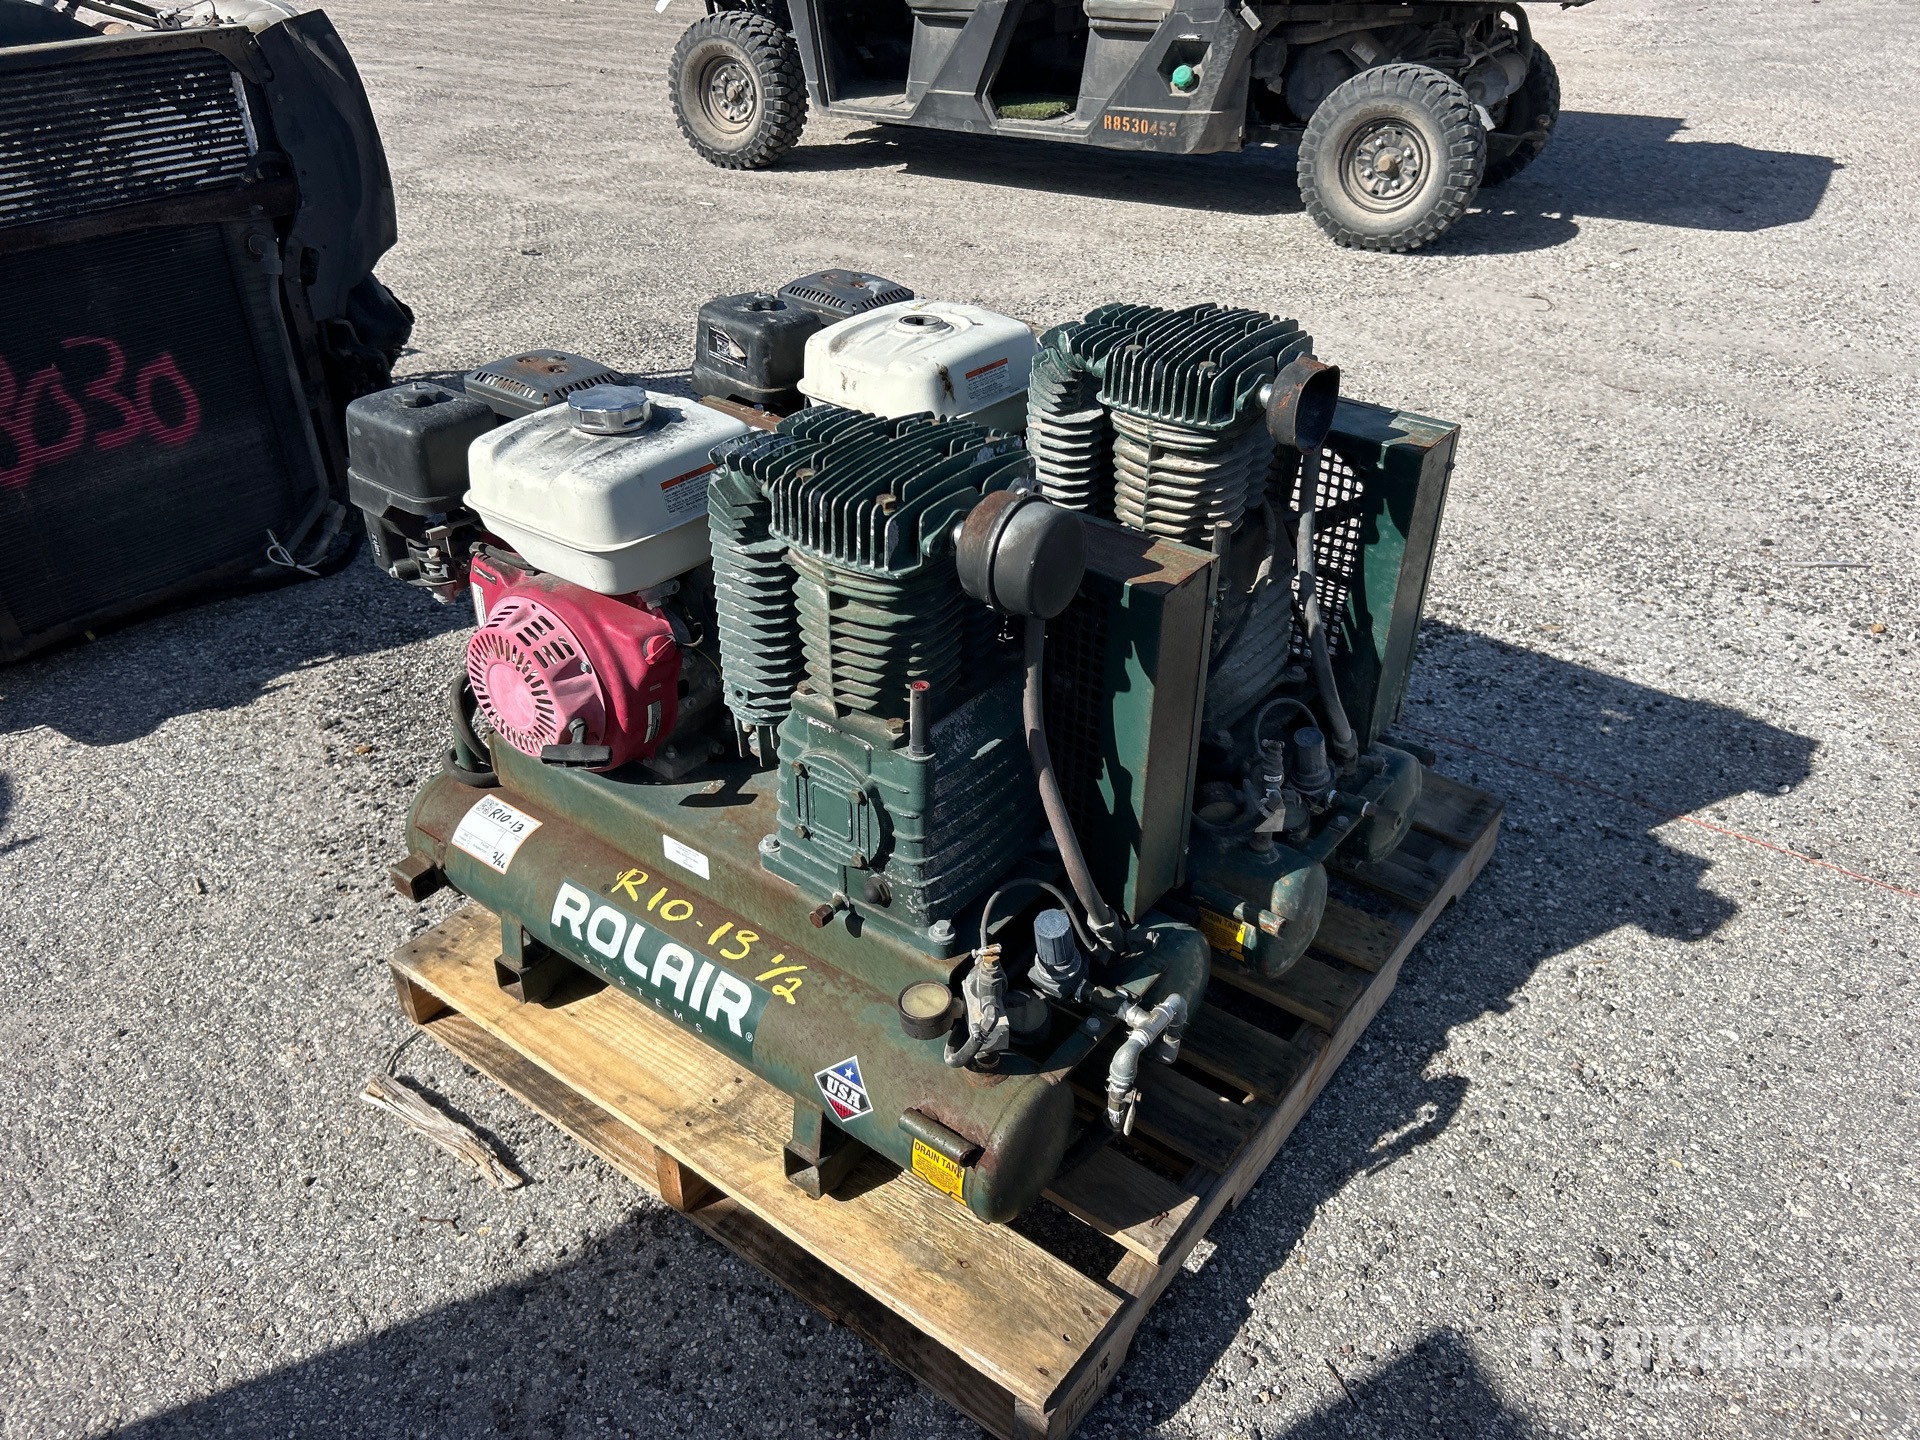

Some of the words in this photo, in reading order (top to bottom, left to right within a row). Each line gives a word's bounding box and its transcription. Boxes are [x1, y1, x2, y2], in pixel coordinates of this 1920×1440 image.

[1104, 114, 1178, 137] R8530453
[551, 882, 752, 1038] ROLAIR
[583, 953, 703, 1034] SYSTEMS
[826, 1076, 861, 1110] USA
[914, 1141, 940, 1163] DRAIN
[941, 1157, 964, 1179] TANK
